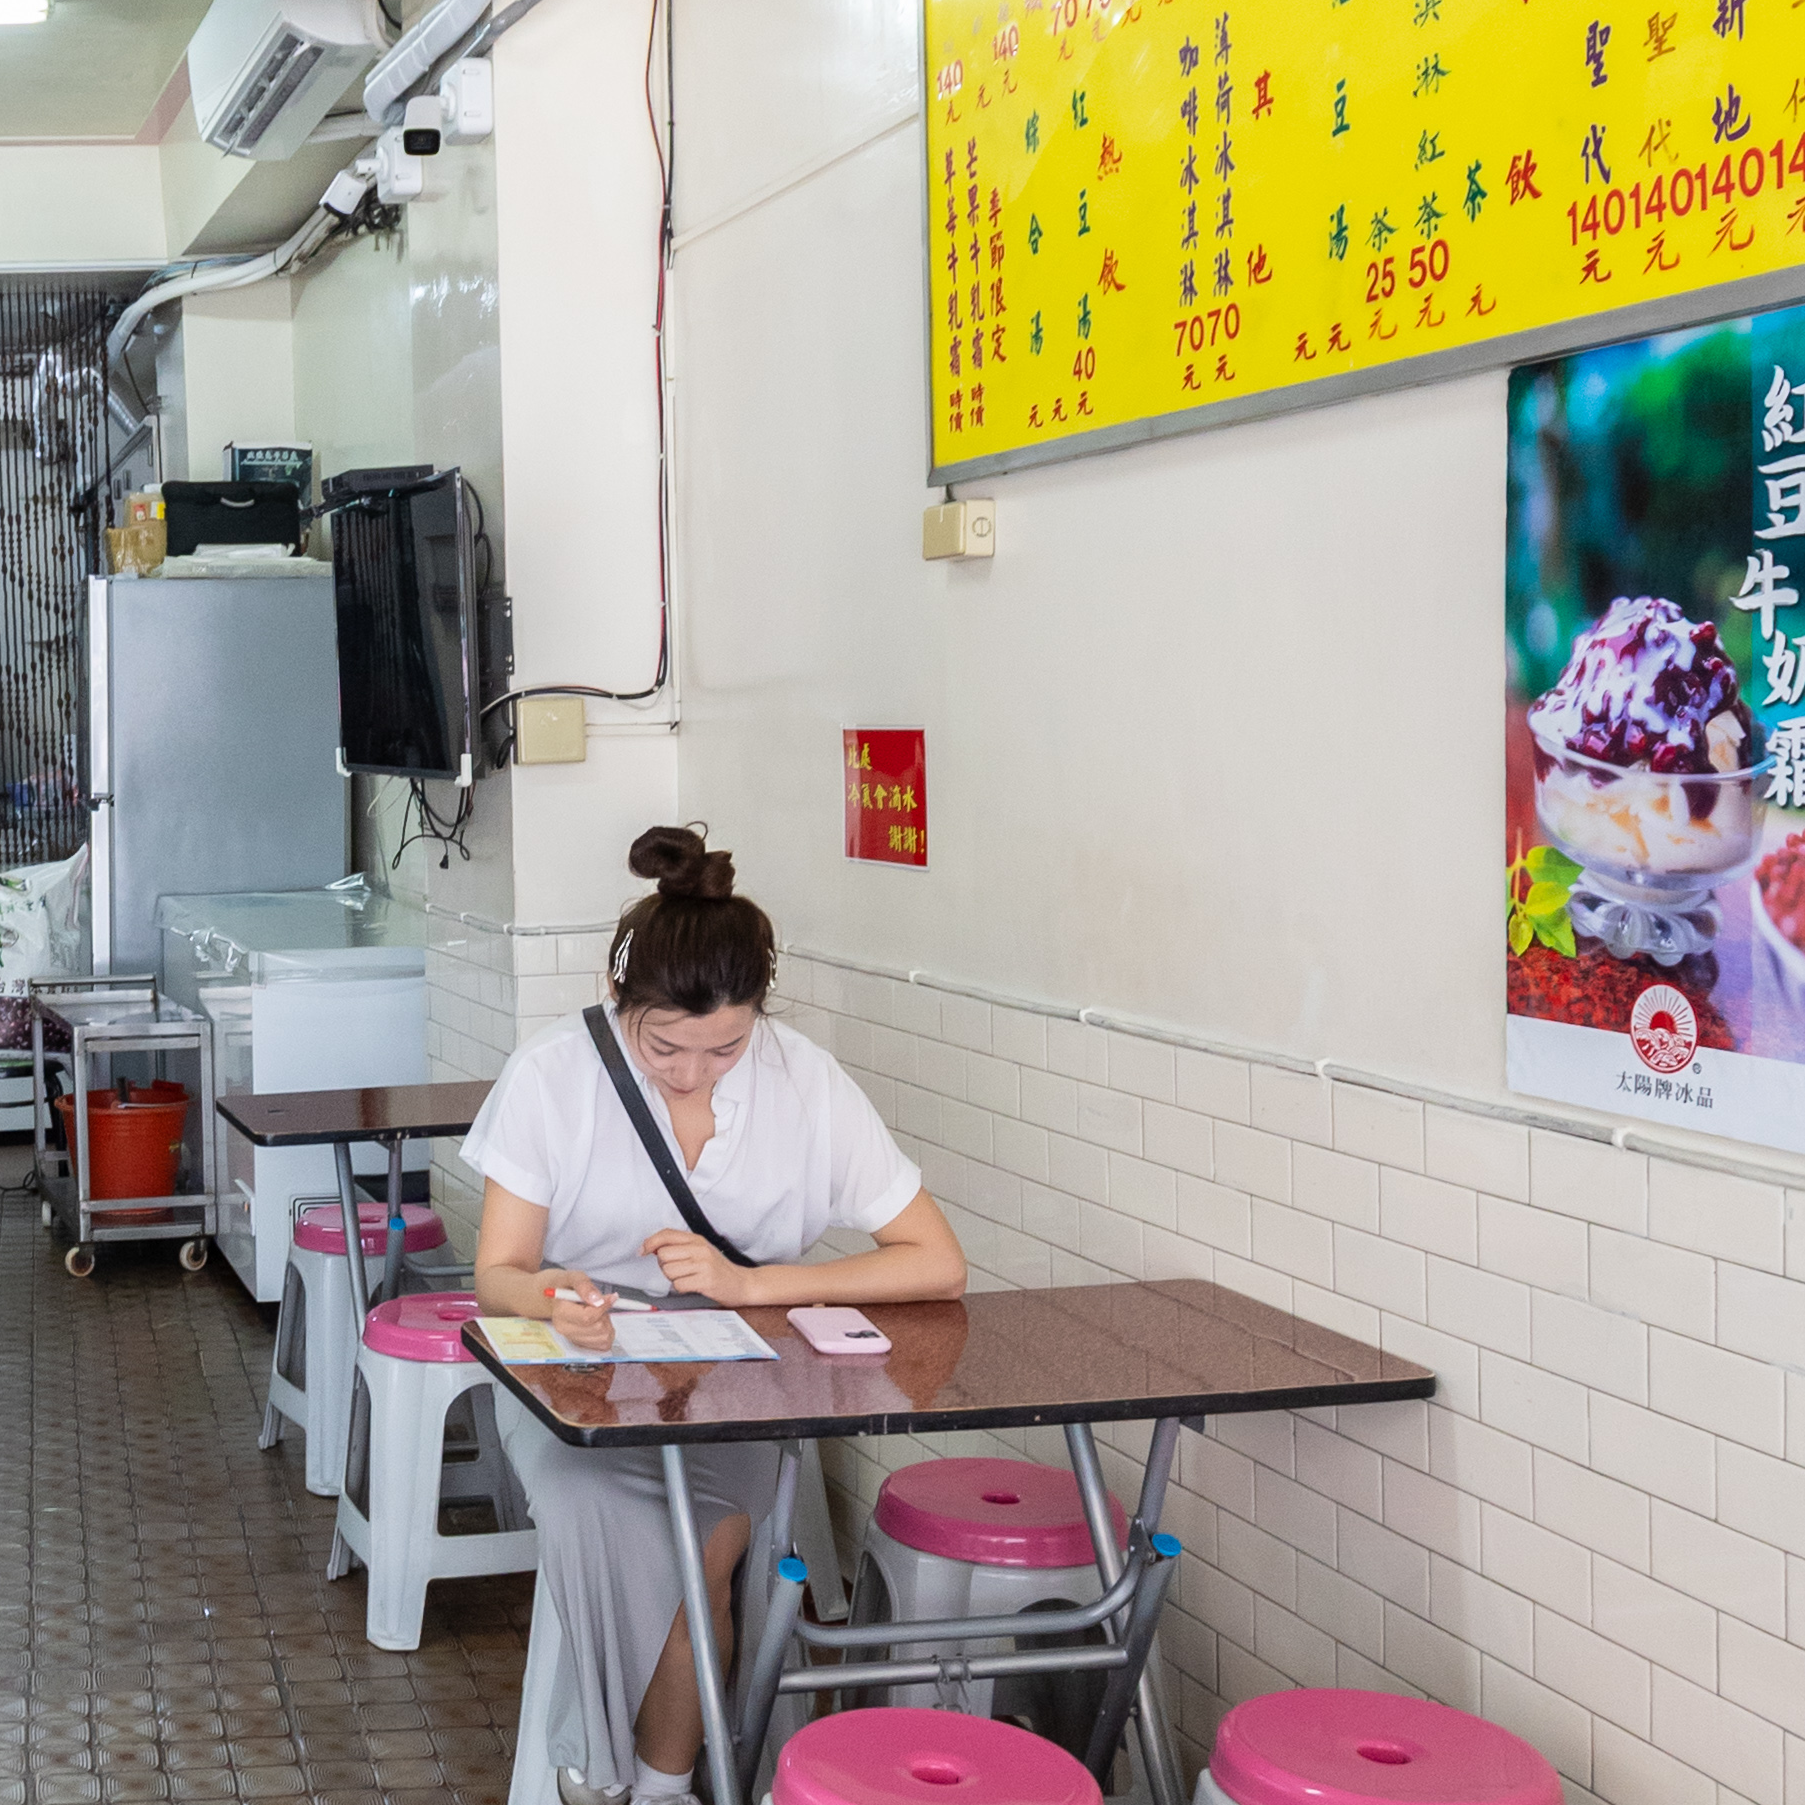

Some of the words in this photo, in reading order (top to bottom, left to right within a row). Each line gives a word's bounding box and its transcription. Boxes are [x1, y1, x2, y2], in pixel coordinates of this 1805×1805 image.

[1071, 89, 1092, 341] 紅豆湯
[1096, 131, 1127, 296] 熱飲
[1178, 35, 1201, 309] 咖啡冰淇淋
[1213, 11, 1235, 299] 薄荷冰淇淋
[1246, 69, 1275, 288] 其他
[1566, 175, 1627, 246] 140
[1630, 162, 1696, 231] 140
[1695, 138, 1767, 213] 140
[944, 146, 964, 378] 草莓牛乳霜
[965, 135, 986, 370] 芒果牛乳霜
[987, 186, 1007, 364] 季節限定
[1024, 107, 1045, 357] 綜合湯
[1365, 255, 1397, 303] 25
[1407, 238, 1451, 290] 50
[1071, 345, 1097, 383] 40
[1172, 315, 1206, 357] 70
[1206, 302, 1241, 347] 70
[1614, 1071, 1715, 1110] 太陽牌冰品
